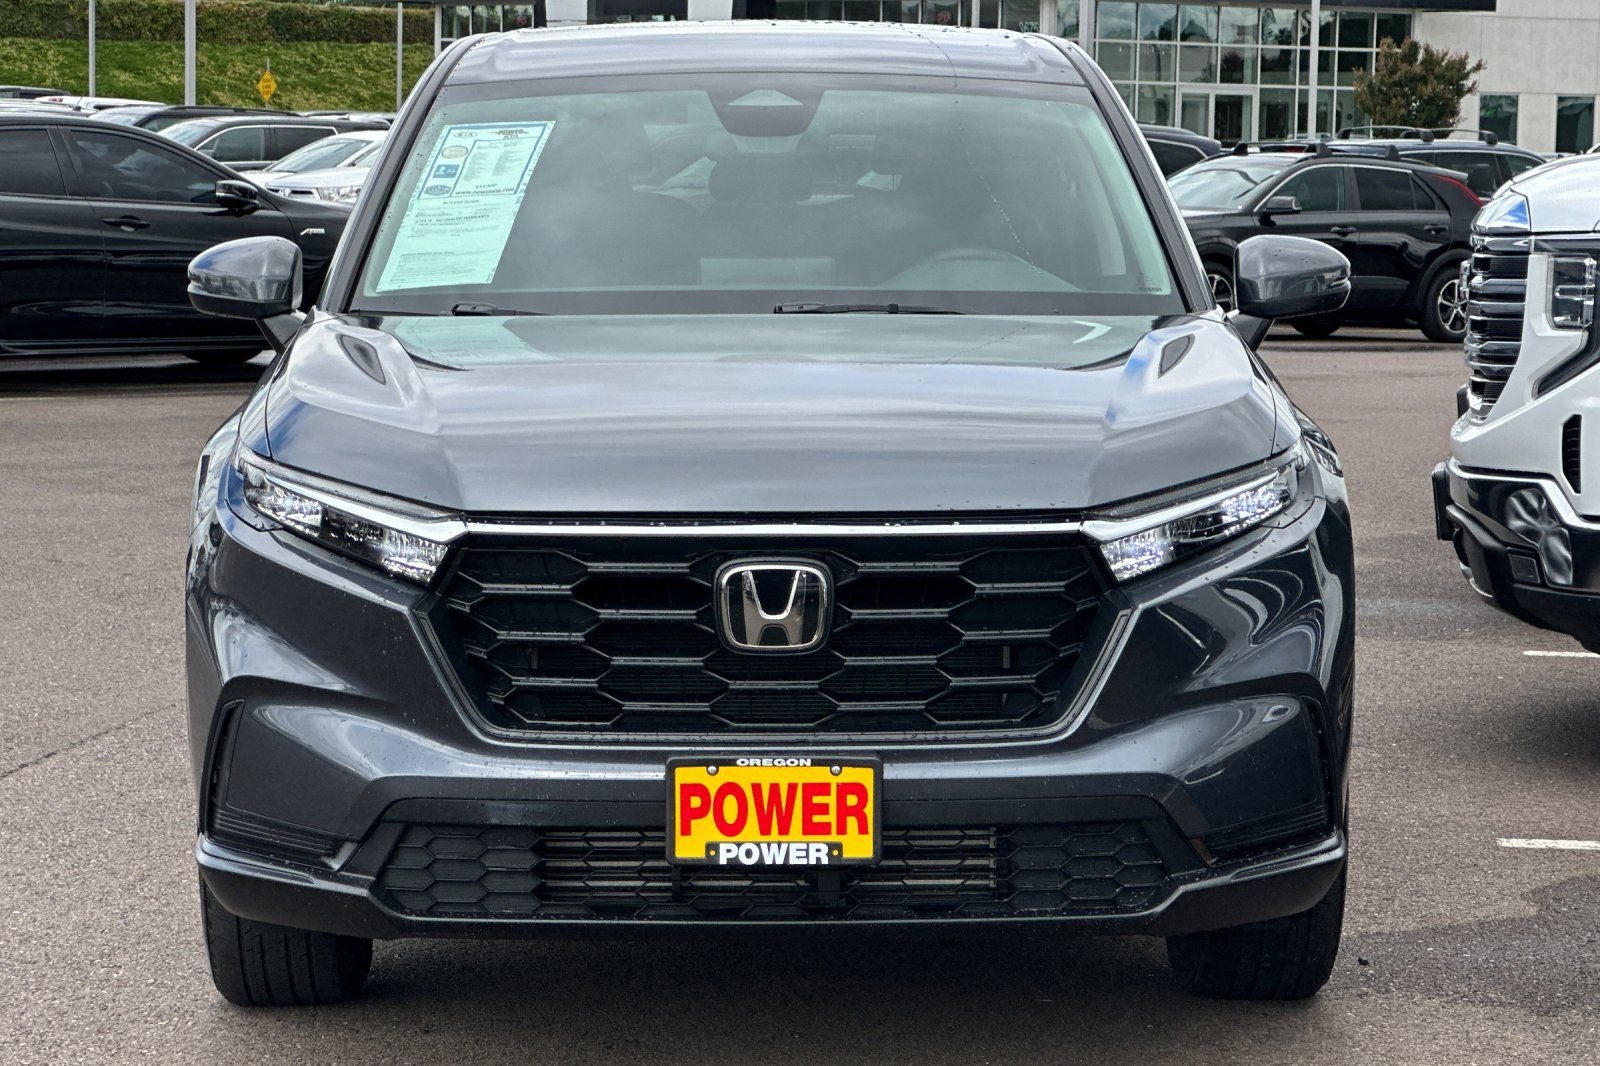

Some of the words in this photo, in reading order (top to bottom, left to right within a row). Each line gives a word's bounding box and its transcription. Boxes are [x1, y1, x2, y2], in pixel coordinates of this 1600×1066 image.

[736, 758, 811, 767] OREGON
[679, 781, 869, 837] POWER
[719, 843, 829, 865] POWER
